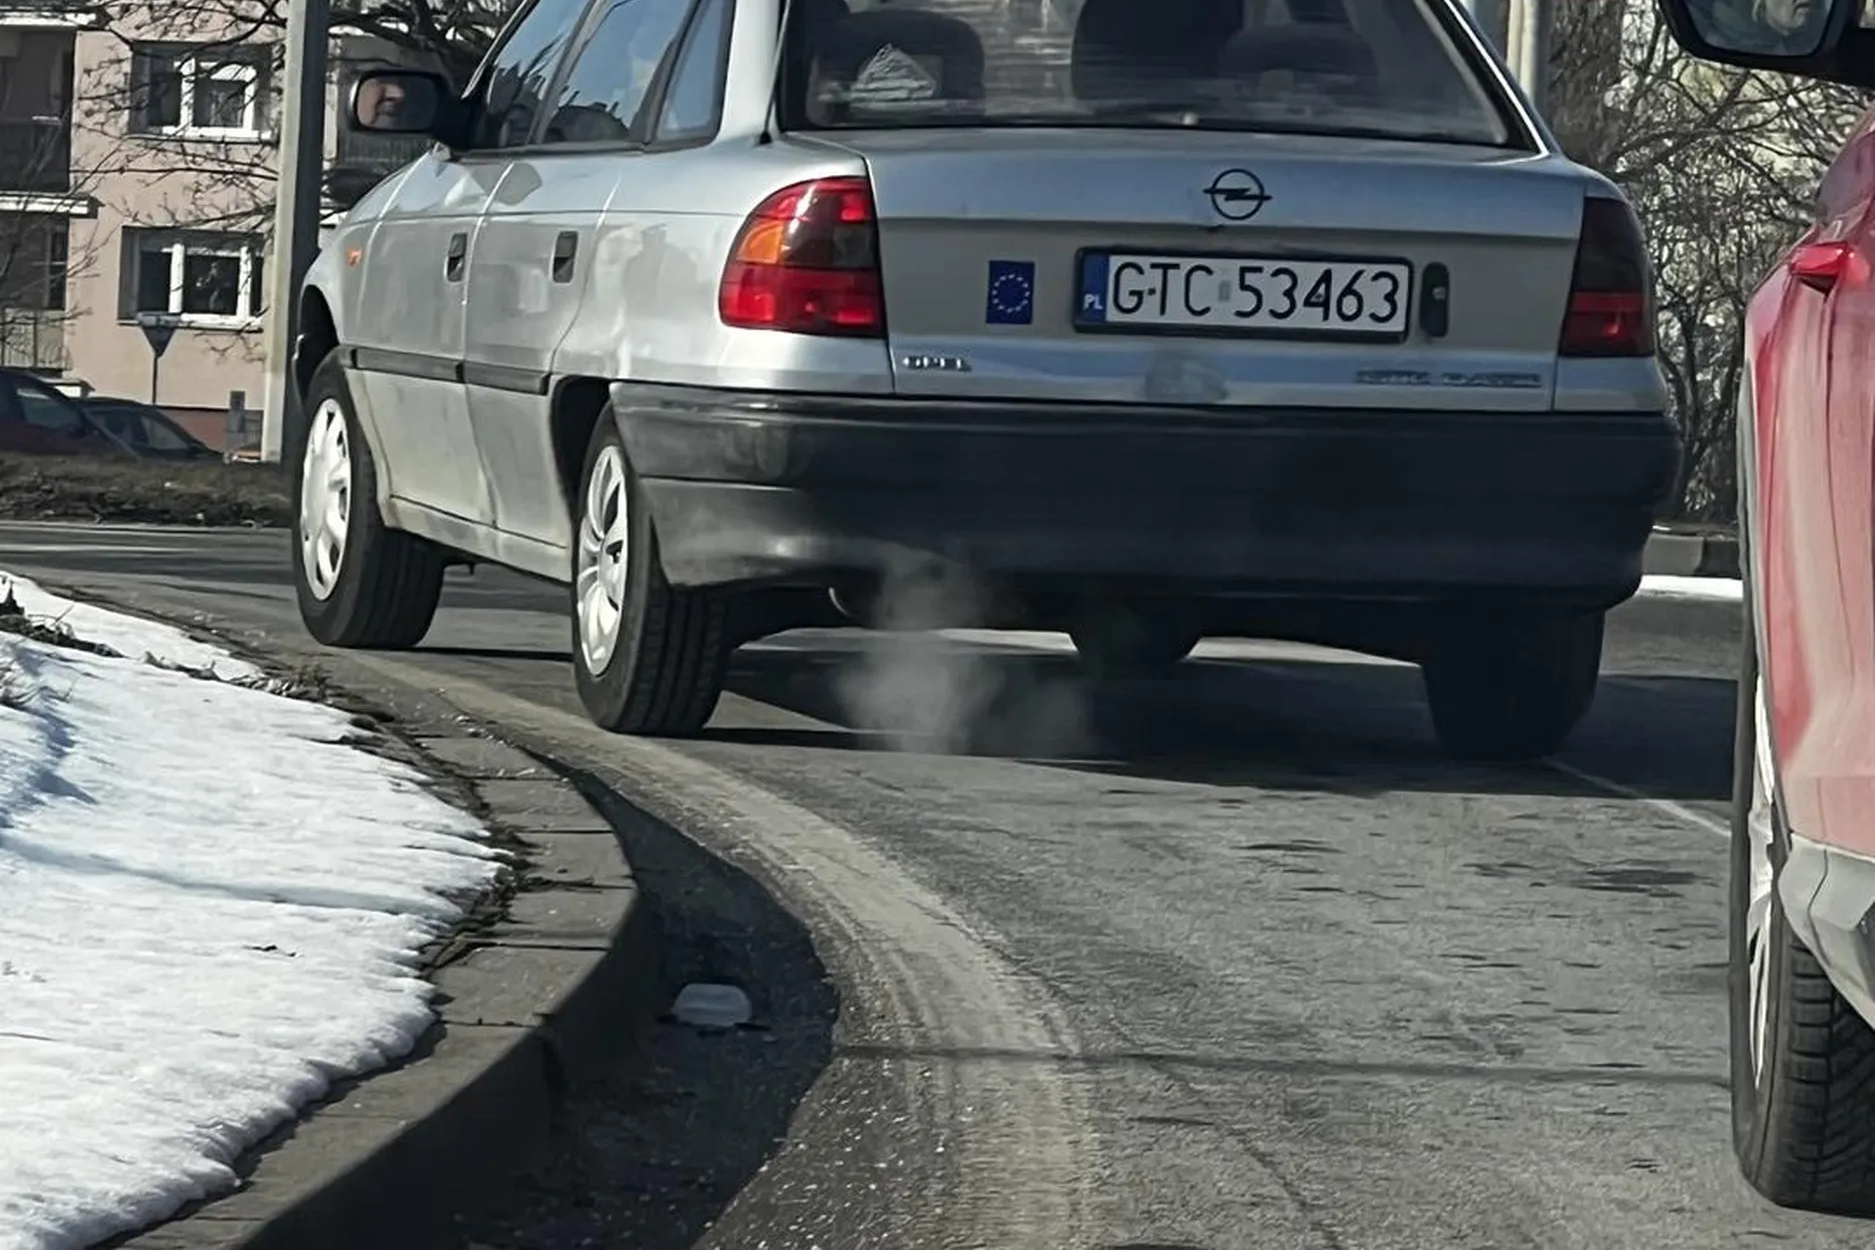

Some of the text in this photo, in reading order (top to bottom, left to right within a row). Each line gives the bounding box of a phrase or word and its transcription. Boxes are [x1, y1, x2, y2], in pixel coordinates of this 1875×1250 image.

[1083, 294, 1103, 310] PL
[1113, 262, 1399, 324] GTC 53463
